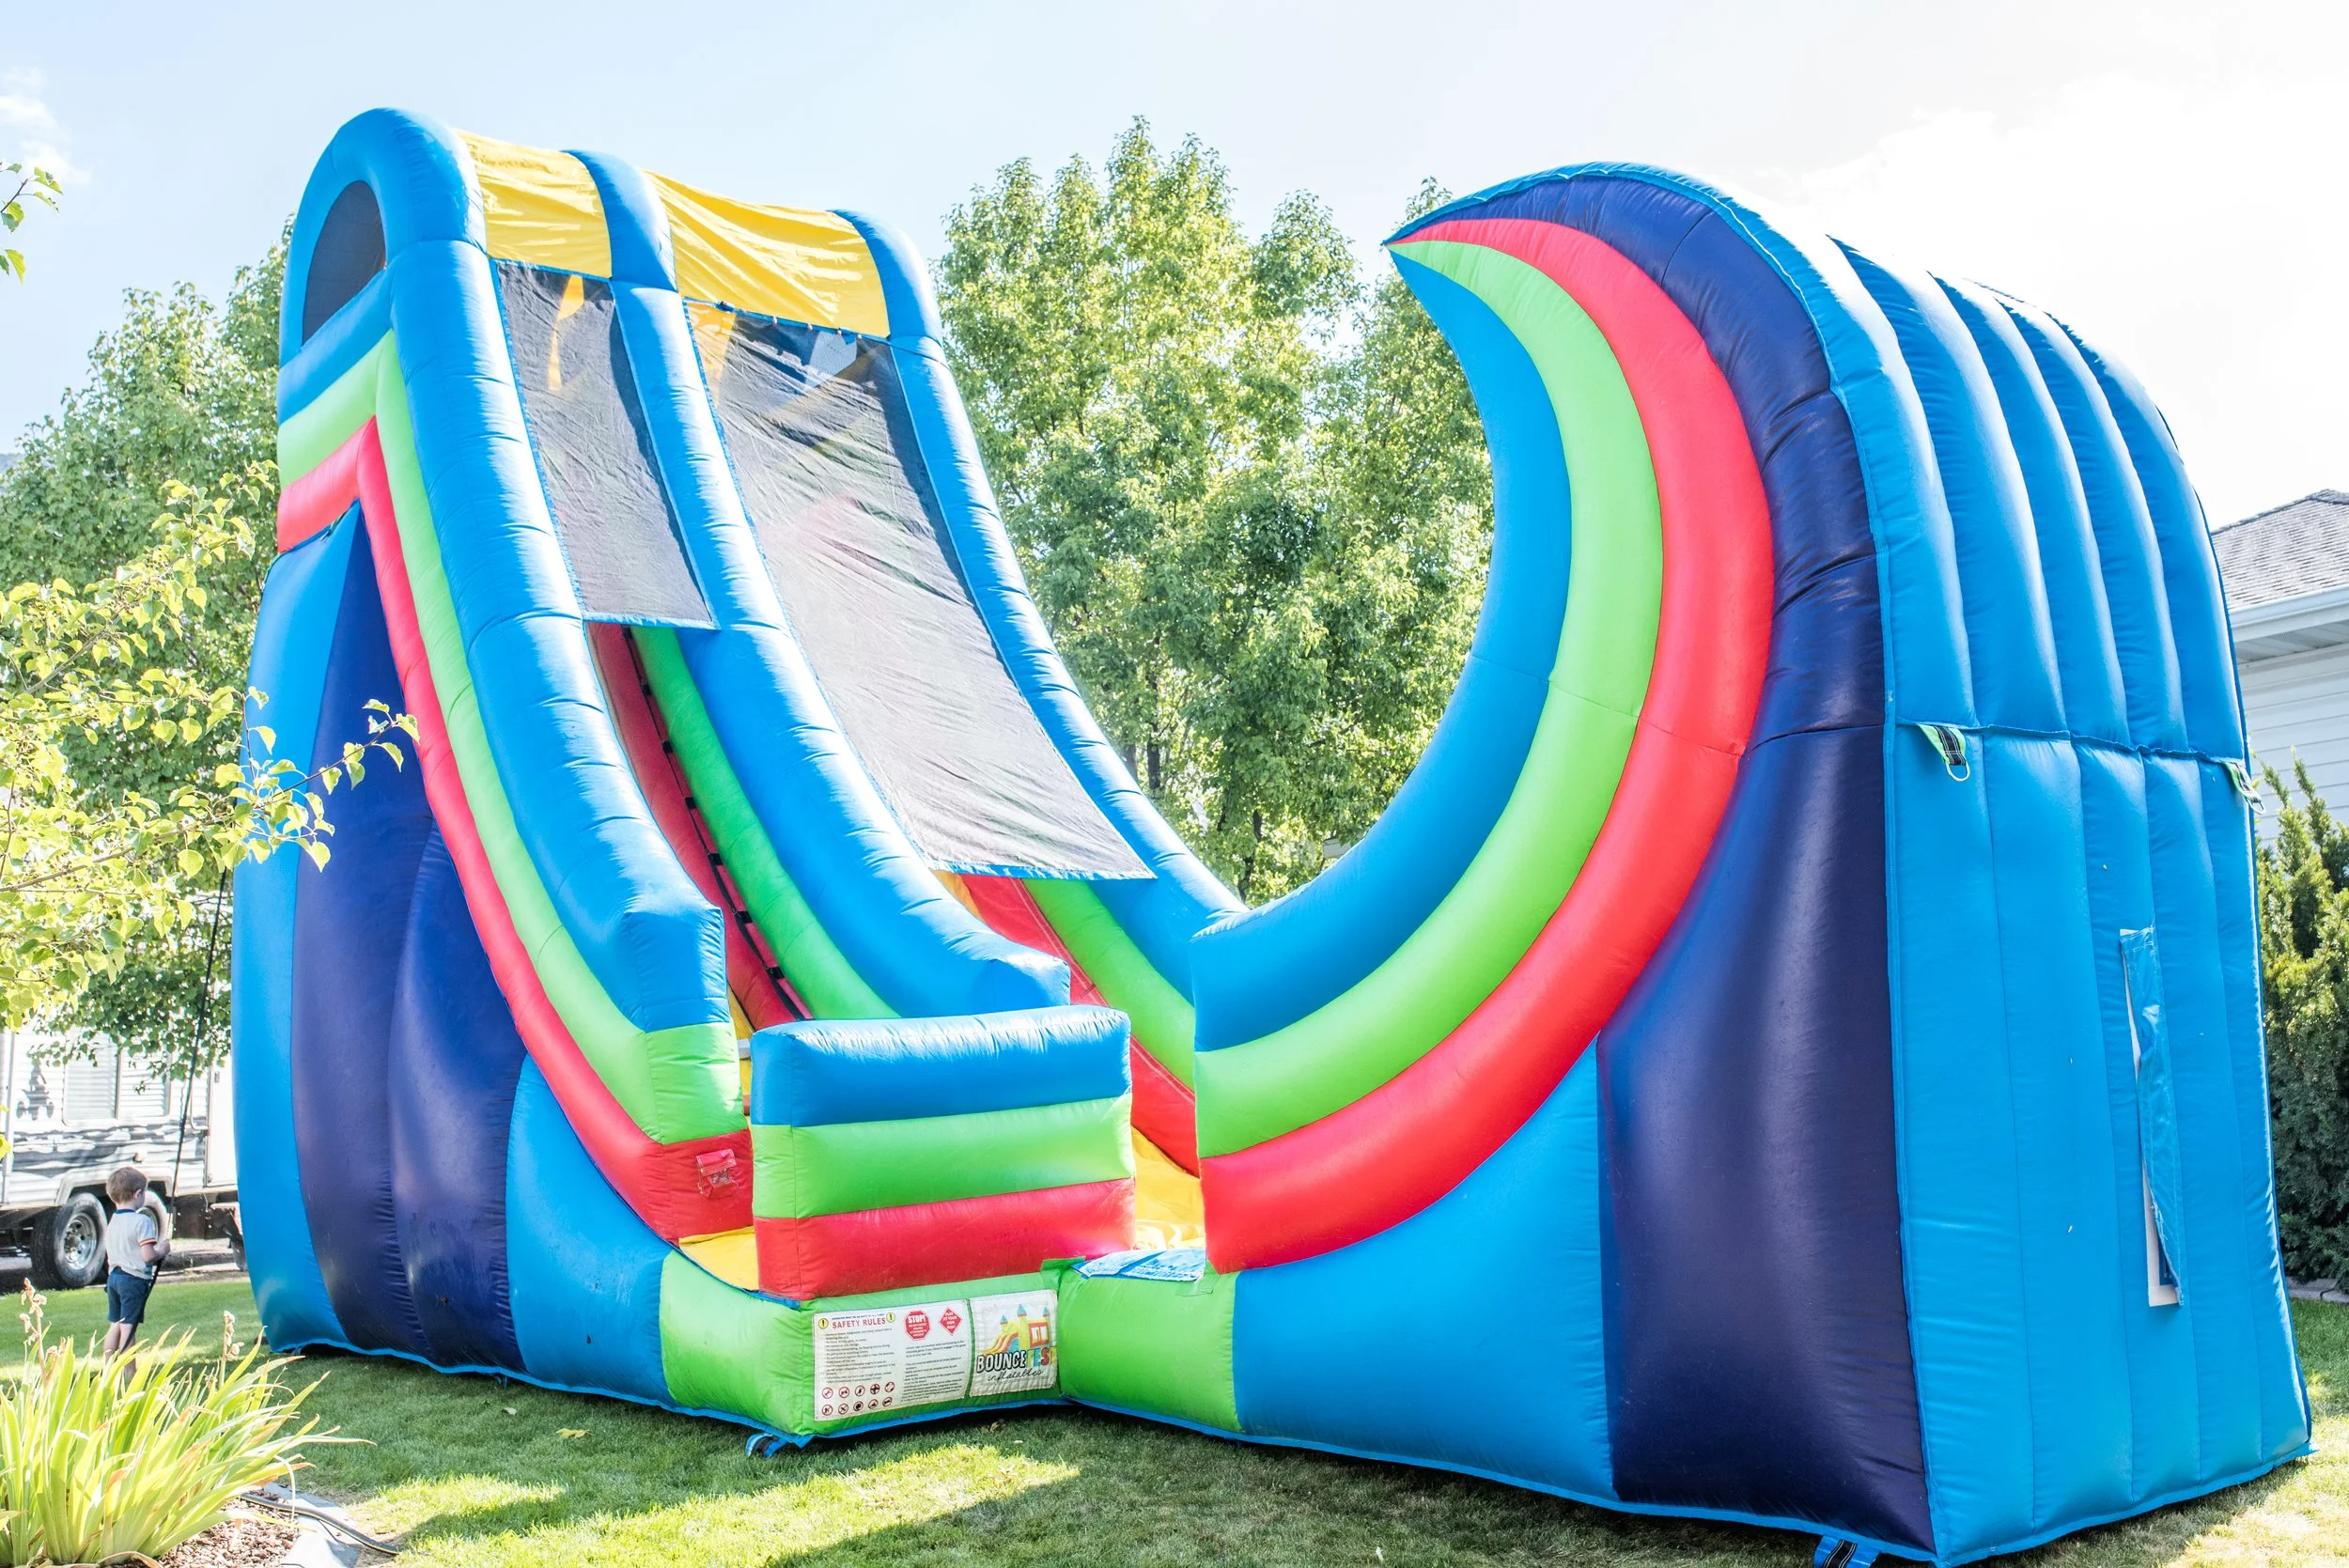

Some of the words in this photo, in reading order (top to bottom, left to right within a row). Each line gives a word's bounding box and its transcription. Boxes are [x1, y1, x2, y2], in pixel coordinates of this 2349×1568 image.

[832, 1320, 861, 1329] SAFETY
[863, 1317, 886, 1327] RULES
[988, 1368, 1044, 1381] inflatables
